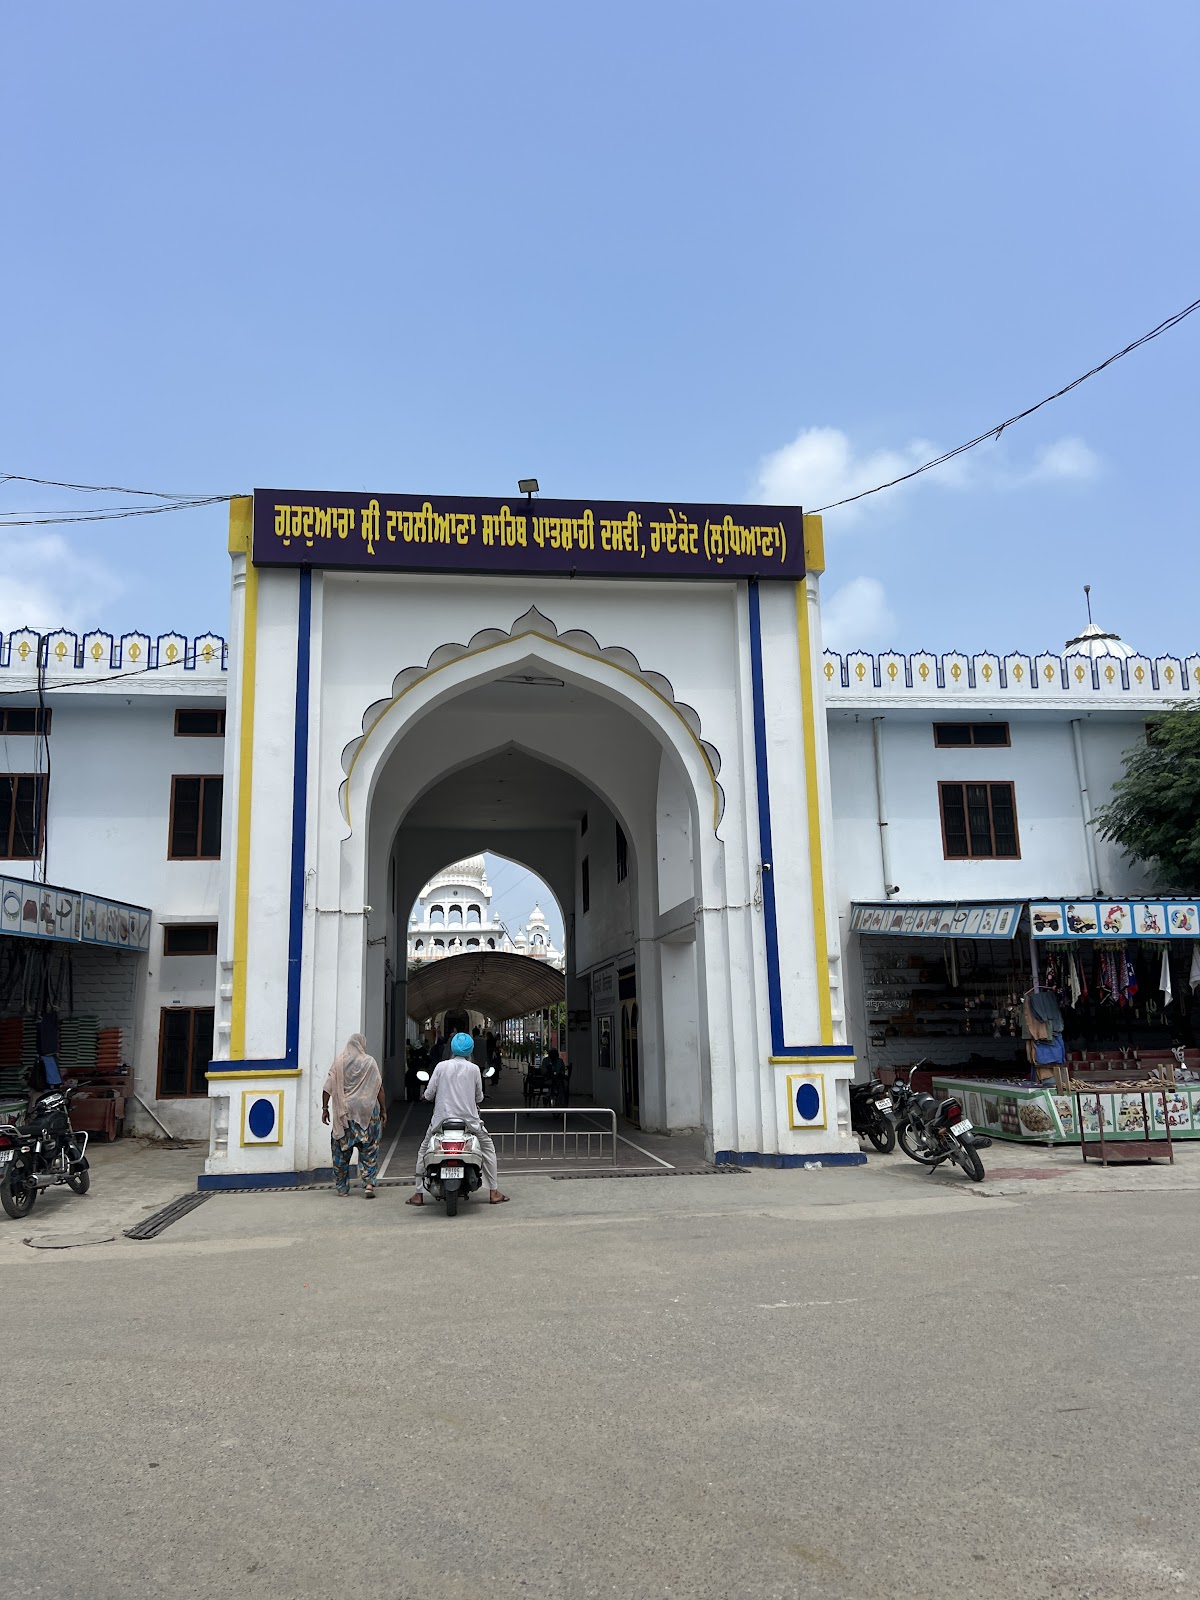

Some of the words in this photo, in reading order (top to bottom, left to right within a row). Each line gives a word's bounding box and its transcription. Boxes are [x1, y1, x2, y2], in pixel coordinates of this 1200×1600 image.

[274, 504, 355, 547] ਗੁਰਦੁਆਰਾ
[386, 501, 476, 545] ਟਾਹਲੀਆਣਾ
[481, 505, 527, 547] ਸਾਹਿਬ
[532, 509, 595, 552] ਪਾਤਸ਼ਾਹੀ
[599, 510, 646, 559] ਦਸਵੀਂ,
[649, 508, 699, 554] ਰਾਏਕੋਟ
[703, 515, 787, 563] (ਲੁਧਿਆਣਾ)
